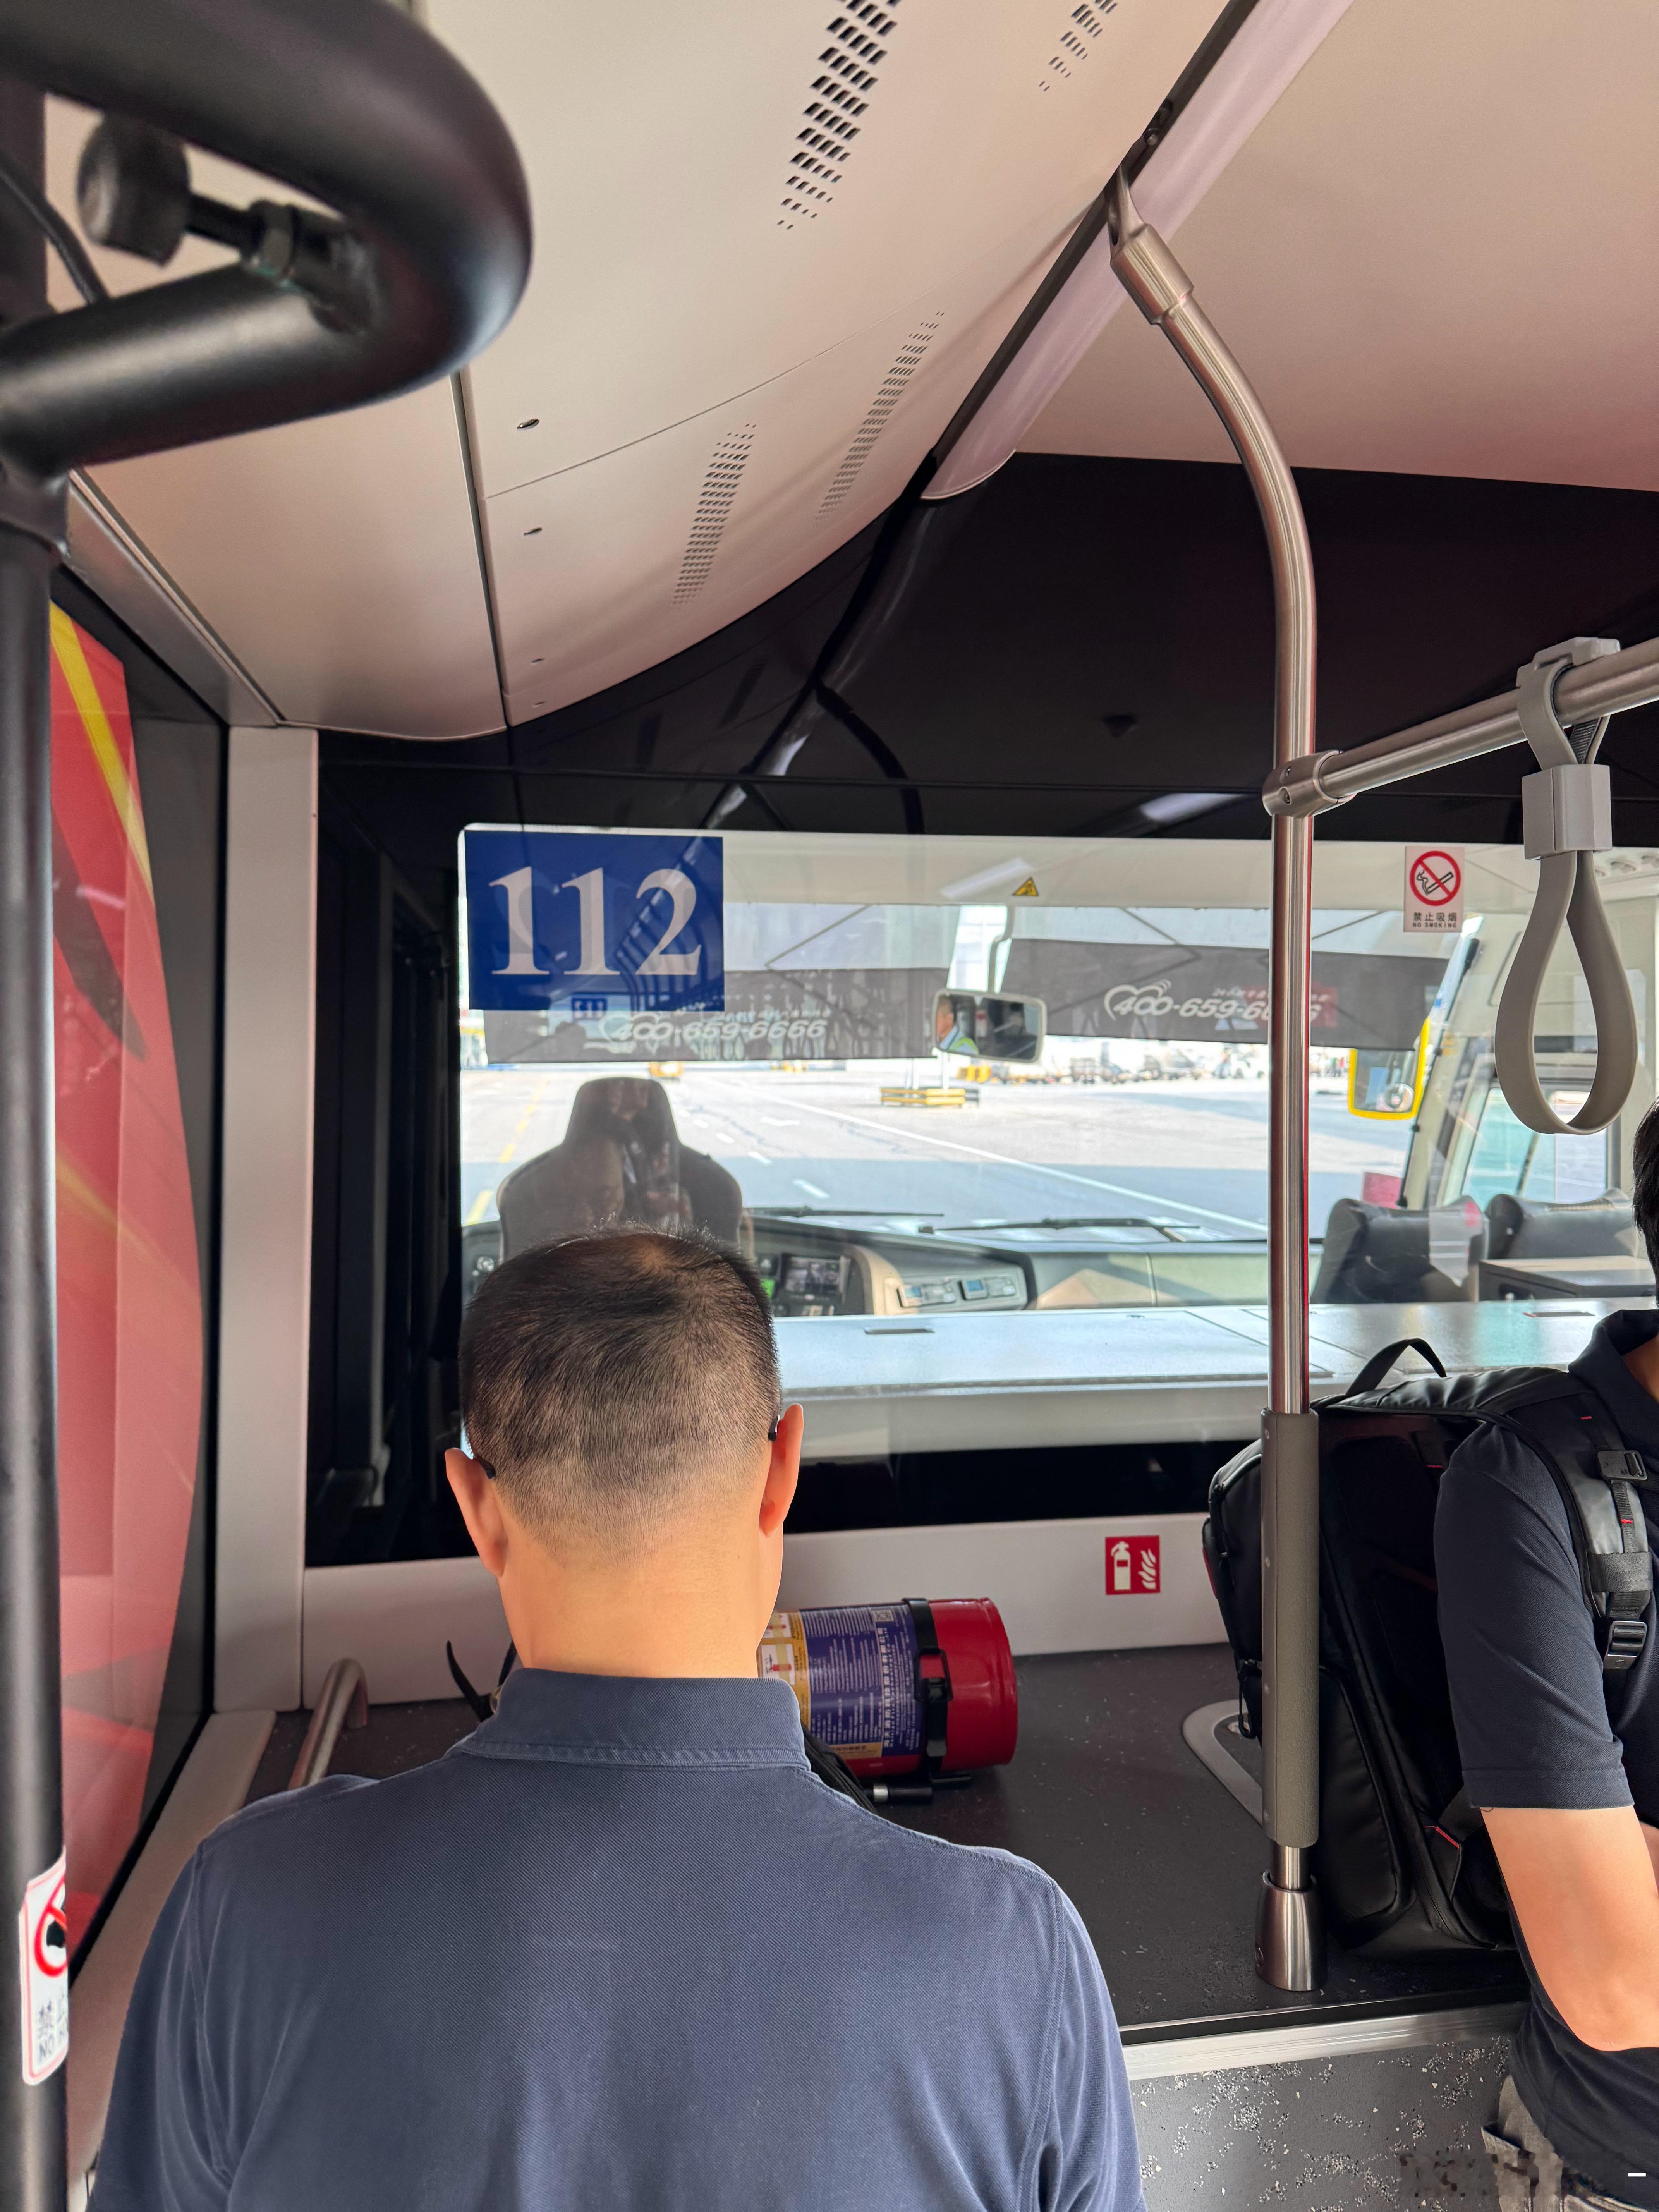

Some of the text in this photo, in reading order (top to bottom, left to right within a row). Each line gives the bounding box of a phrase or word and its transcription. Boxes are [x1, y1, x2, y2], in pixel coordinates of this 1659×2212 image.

[489, 865, 702, 976] 112
[1413, 912, 1457, 922] 禁止吸烟
